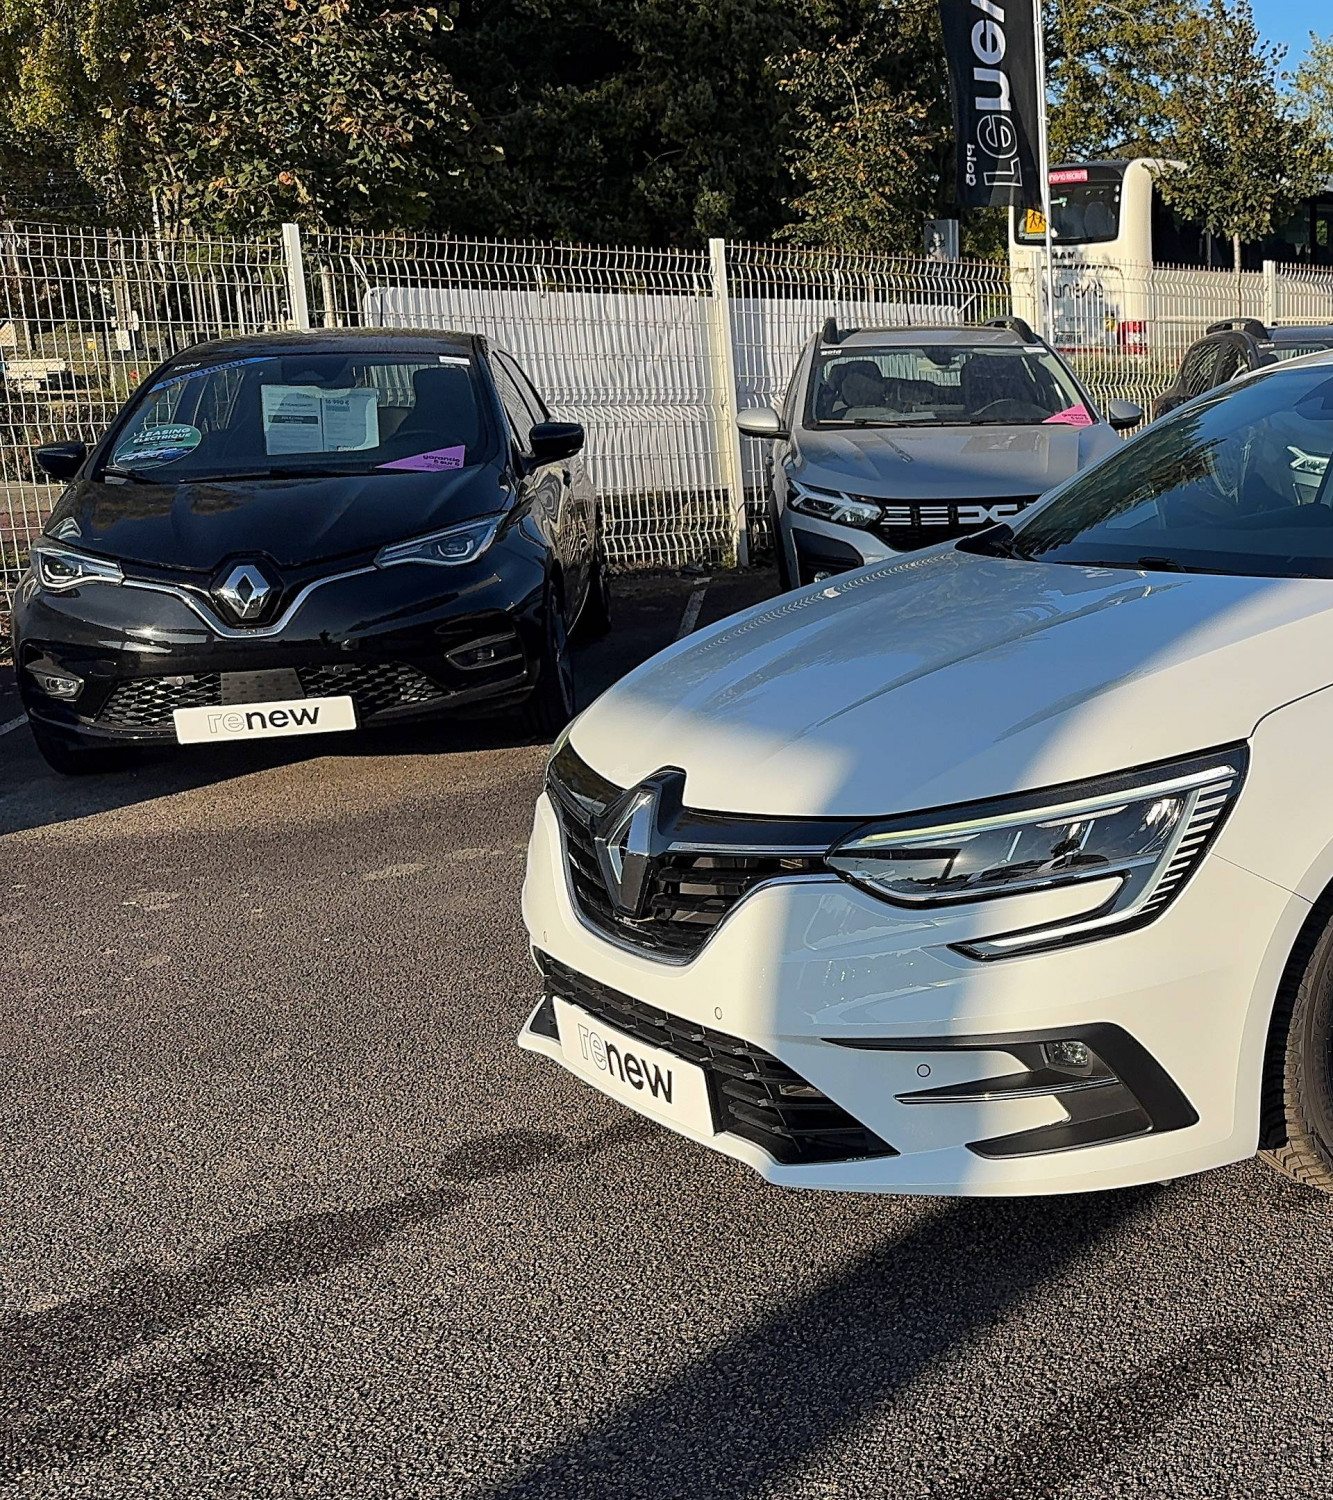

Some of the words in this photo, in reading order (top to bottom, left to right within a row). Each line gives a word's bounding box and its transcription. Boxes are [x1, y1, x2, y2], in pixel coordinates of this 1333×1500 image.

[139, 427, 191, 438] LEASING
[422, 455, 461, 463] garantie
[207, 706, 320, 734] renew
[577, 1023, 673, 1104] renew
